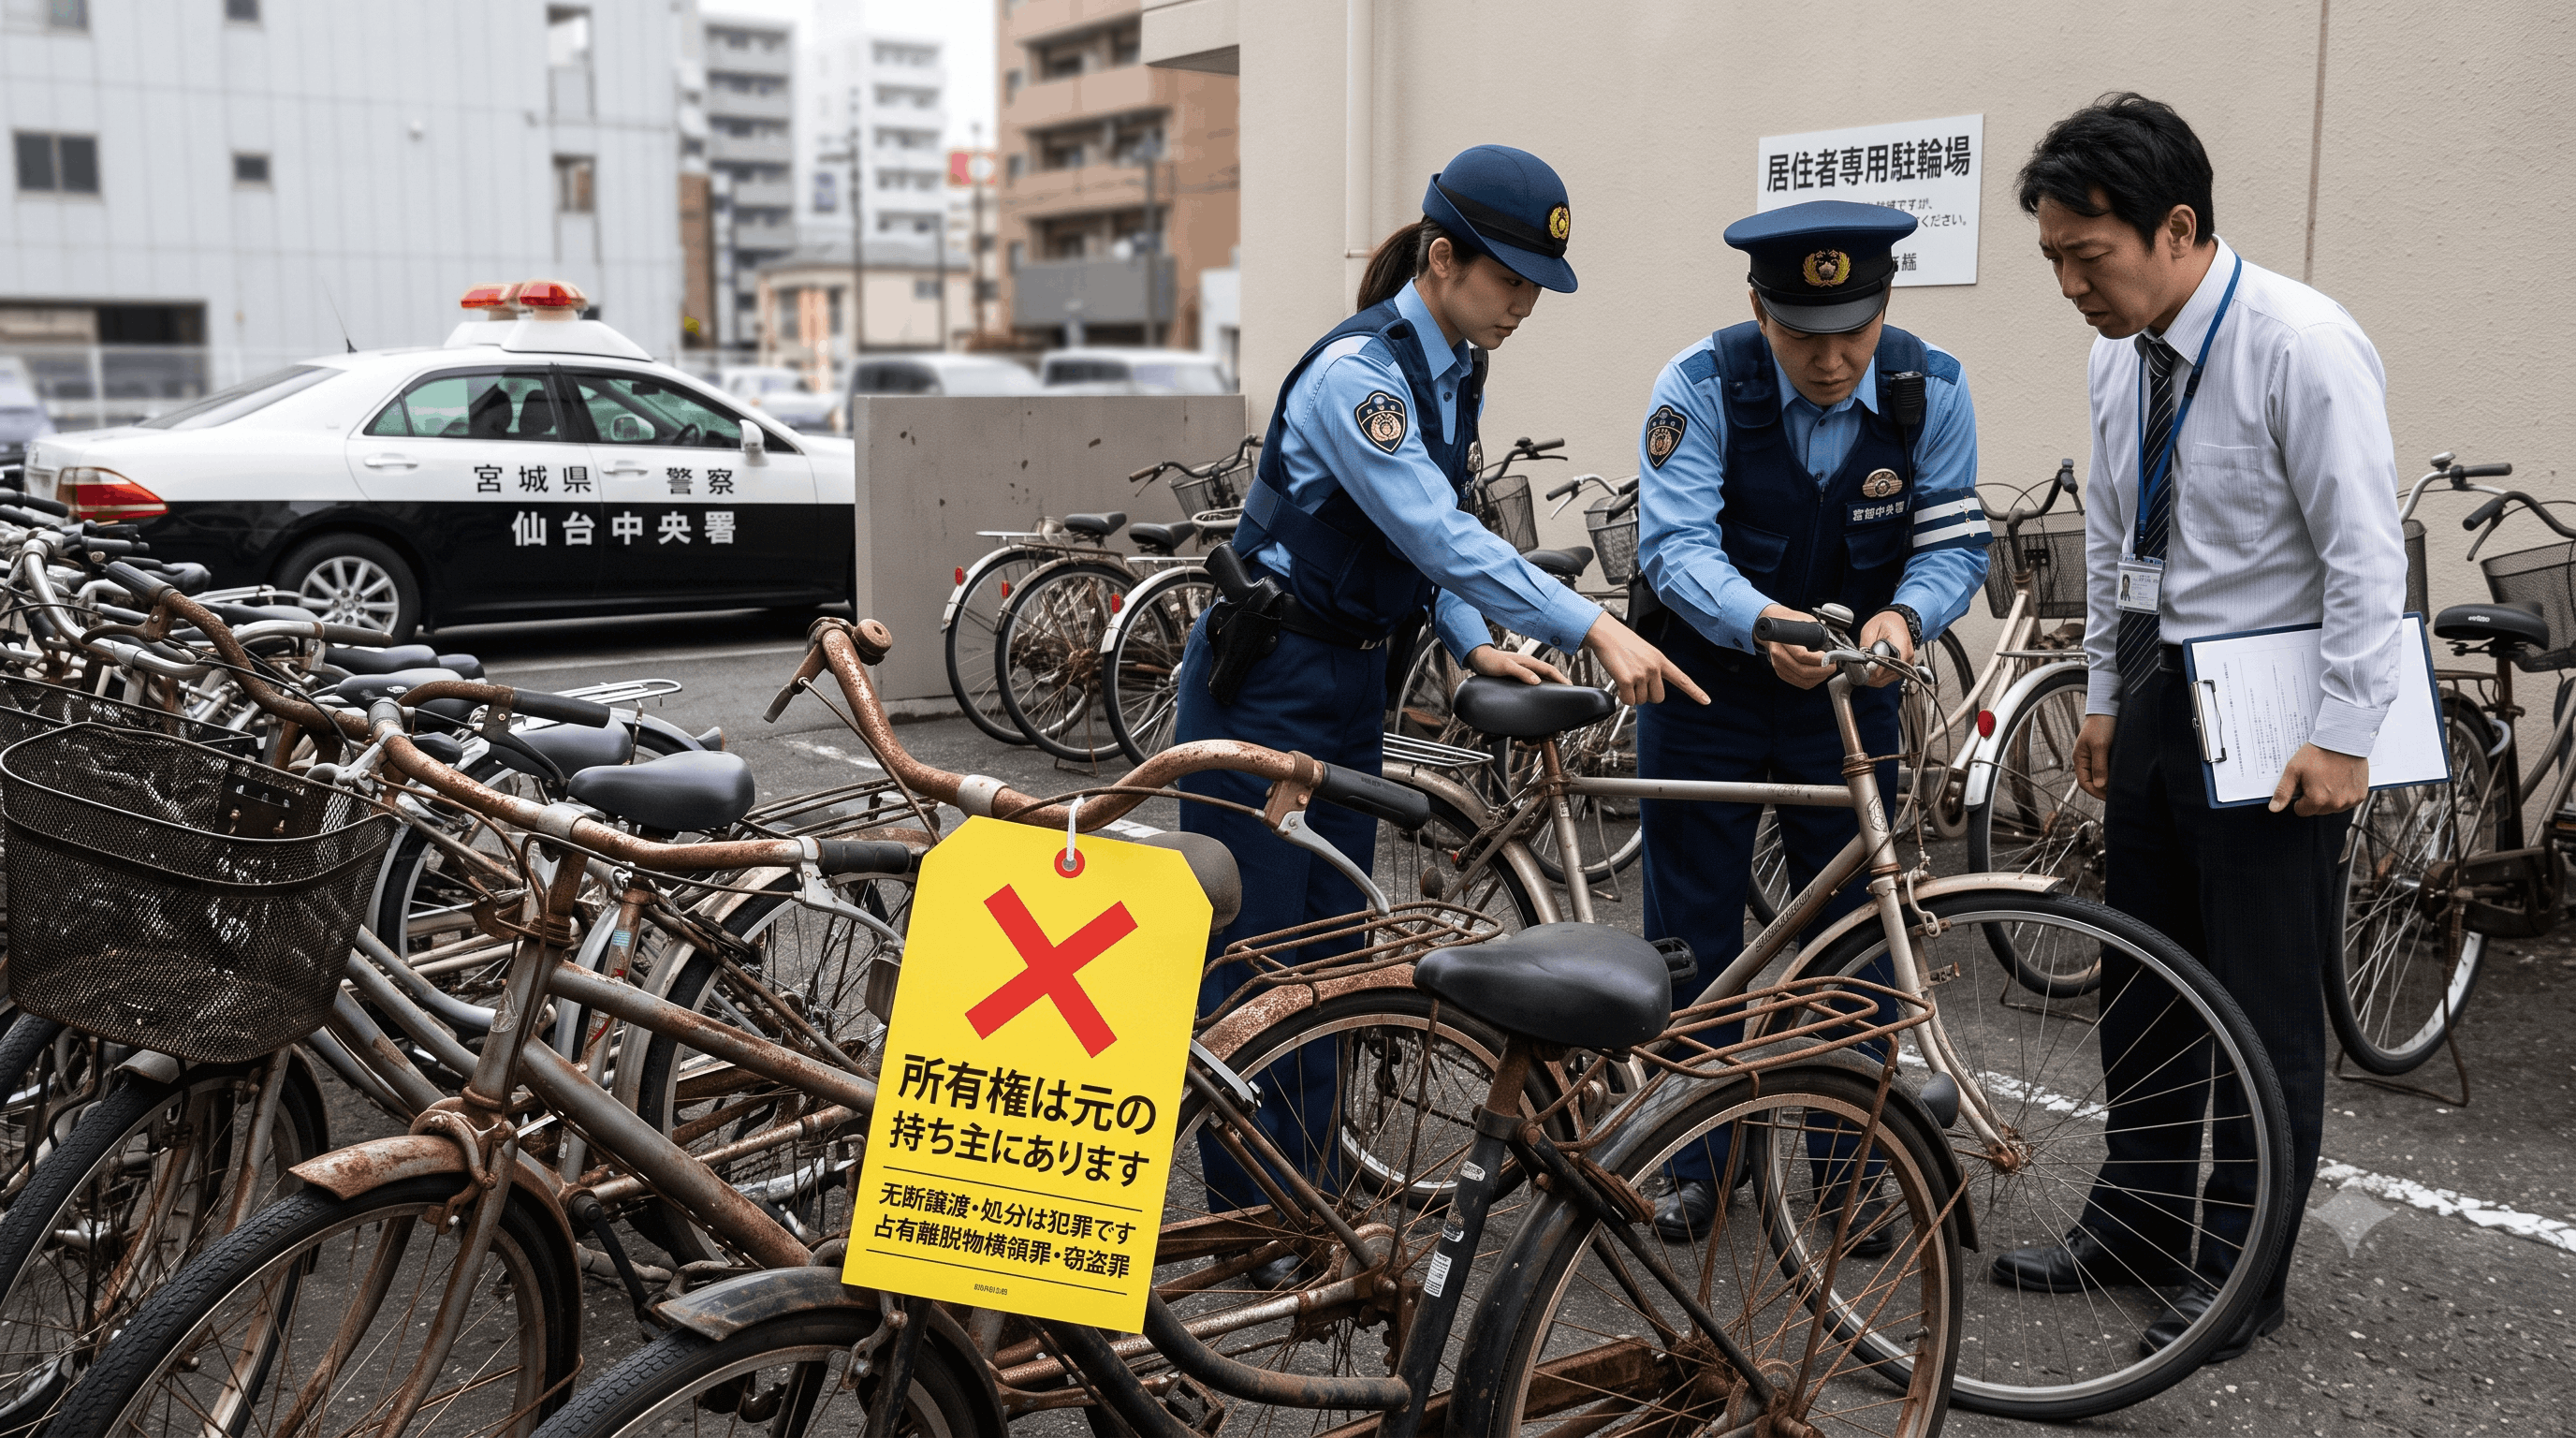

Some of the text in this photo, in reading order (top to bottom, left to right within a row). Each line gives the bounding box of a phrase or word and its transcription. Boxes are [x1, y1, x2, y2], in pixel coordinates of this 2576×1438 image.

[1767, 136, 1970, 192] 居住者専用駐輪場
[1917, 214, 1967, 227] ください。
[474, 464, 734, 494] 宮城県 警察
[512, 511, 736, 546] 仙台中央署
[899, 1054, 1156, 1135] 所有権は元の
[890, 1110, 1149, 1186] 持ち主にあります
